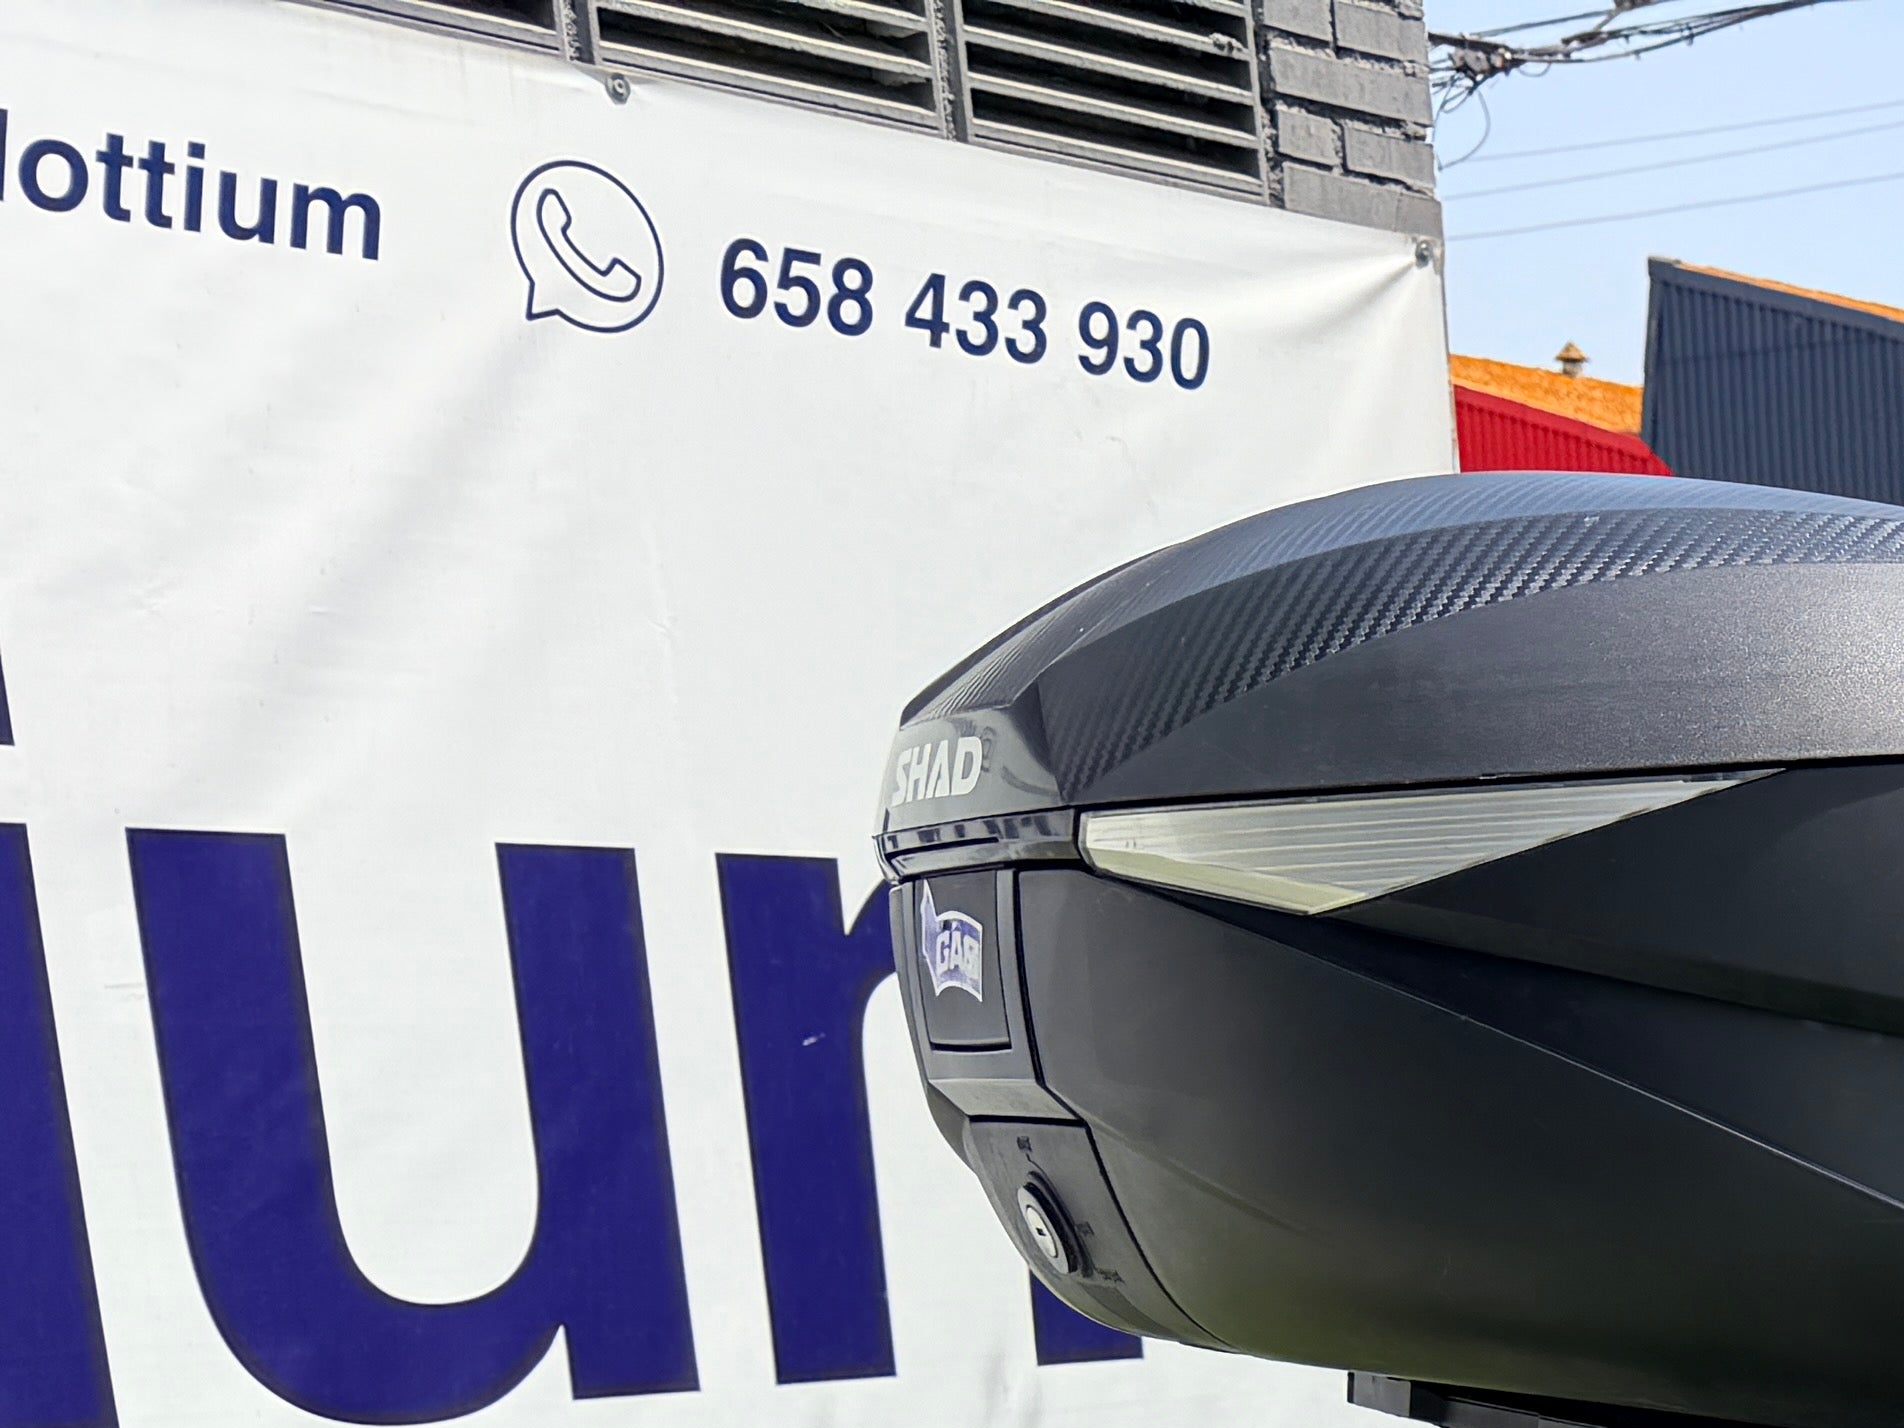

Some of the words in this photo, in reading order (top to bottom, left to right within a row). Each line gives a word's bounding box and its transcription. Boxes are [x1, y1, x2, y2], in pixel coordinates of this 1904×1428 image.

[0, 109, 382, 260] ottium
[719, 237, 876, 338] 658
[903, 271, 1048, 367] 433
[1075, 300, 1210, 391] 930
[892, 735, 983, 807] SHAD
